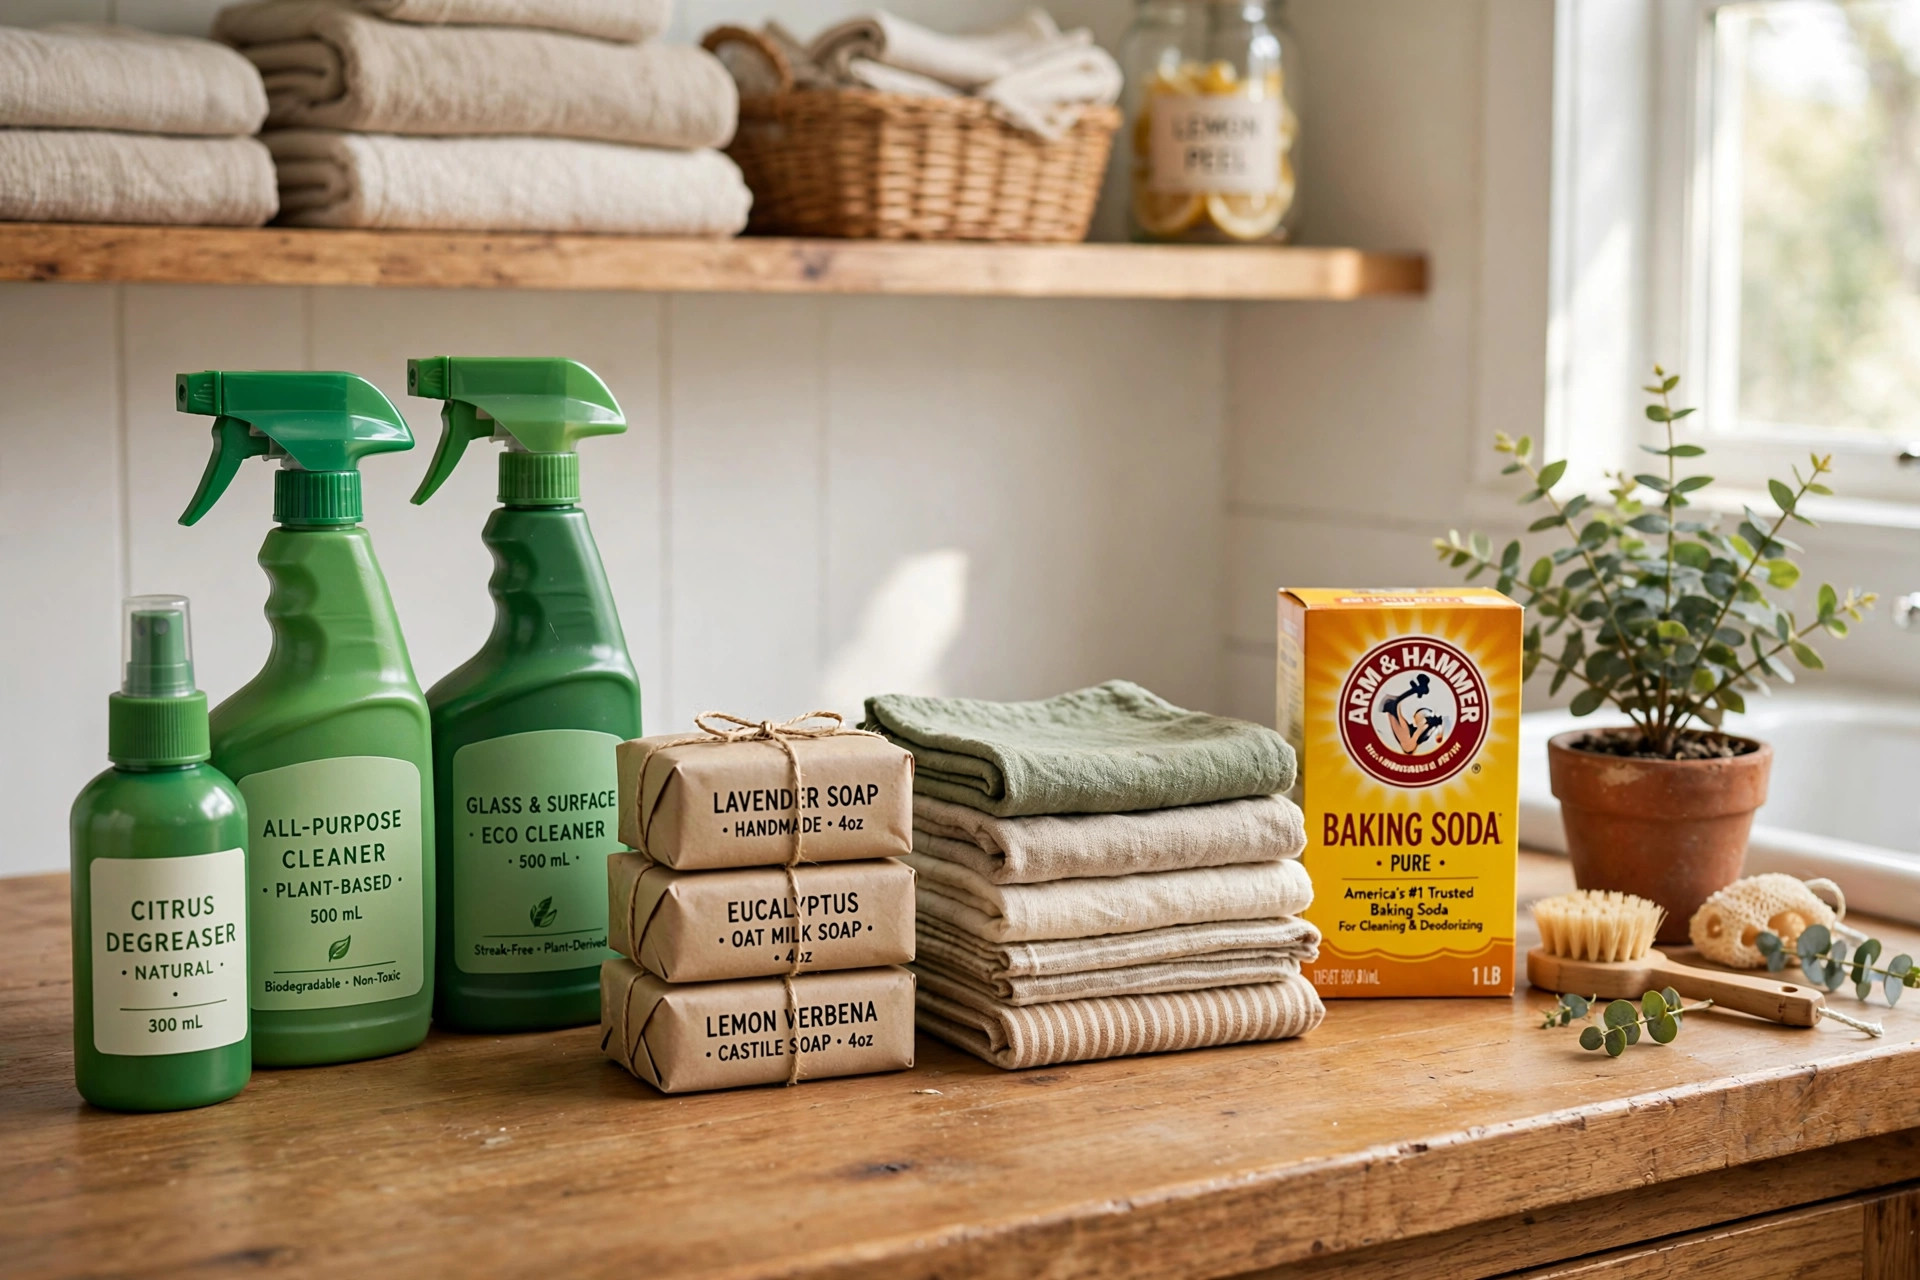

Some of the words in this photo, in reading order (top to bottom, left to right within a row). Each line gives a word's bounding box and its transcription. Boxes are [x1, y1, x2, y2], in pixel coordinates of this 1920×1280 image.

[1348, 666, 1382, 725] ARM
[1379, 654, 1400, 675] &
[1402, 646, 1480, 724] HAMMER
[466, 796, 522, 814] GLASS
[529, 796, 541, 814] &
[547, 790, 616, 813] SURFACE
[713, 787, 819, 814] LAVENDER
[827, 784, 879, 807] SOAP
[263, 809, 402, 838] ALL-PURPOSE
[482, 826, 518, 844] ECO
[525, 820, 605, 843] CLEANER
[735, 816, 822, 837] HANDMADE
[838, 815, 864, 831] 4oz
[1323, 812, 1423, 847] BAKING
[1431, 811, 1501, 846] SODA
[282, 843, 386, 869] CLEANER
[519, 854, 546, 869] 500
[551, 852, 570, 867] mL
[1391, 854, 1431, 872] PURE
[276, 873, 392, 898] PLANT-BASED
[1344, 886, 1405, 900] America's
[1409, 886, 1423, 899] #1
[1428, 886, 1474, 899] Trusted
[131, 895, 214, 921] CITRUS
[310, 908, 337, 924] 500
[342, 905, 363, 921] mL
[1370, 903, 1414, 919] Baking
[1417, 902, 1448, 916] Soda
[106, 923, 236, 952] DEGREASER
[732, 929, 765, 948] OAT
[771, 924, 812, 945] MILK
[818, 920, 862, 941] SOAP
[1339, 921, 1356, 932] For
[1359, 920, 1405, 934] Cleaning
[1409, 920, 1417, 931] &
[1420, 918, 1483, 933] Deodorizing
[474, 943, 534, 957] Streak-Free
[544, 936, 608, 954] Plant-Derived
[135, 960, 214, 980] NATURAL
[265, 978, 341, 994] Biodegradable
[353, 970, 401, 987] Non-Toxic
[1472, 967, 1479, 985] 1
[1483, 966, 1501, 985] LB
[148, 1018, 177, 1033] 300
[182, 1014, 203, 1031] mL
[706, 1010, 777, 1038] LEMON
[784, 1001, 878, 1030] VERBENA
[718, 1039, 784, 1061] CASTILE
[789, 1033, 831, 1055] SOAP
[848, 1032, 873, 1048] 4oz
